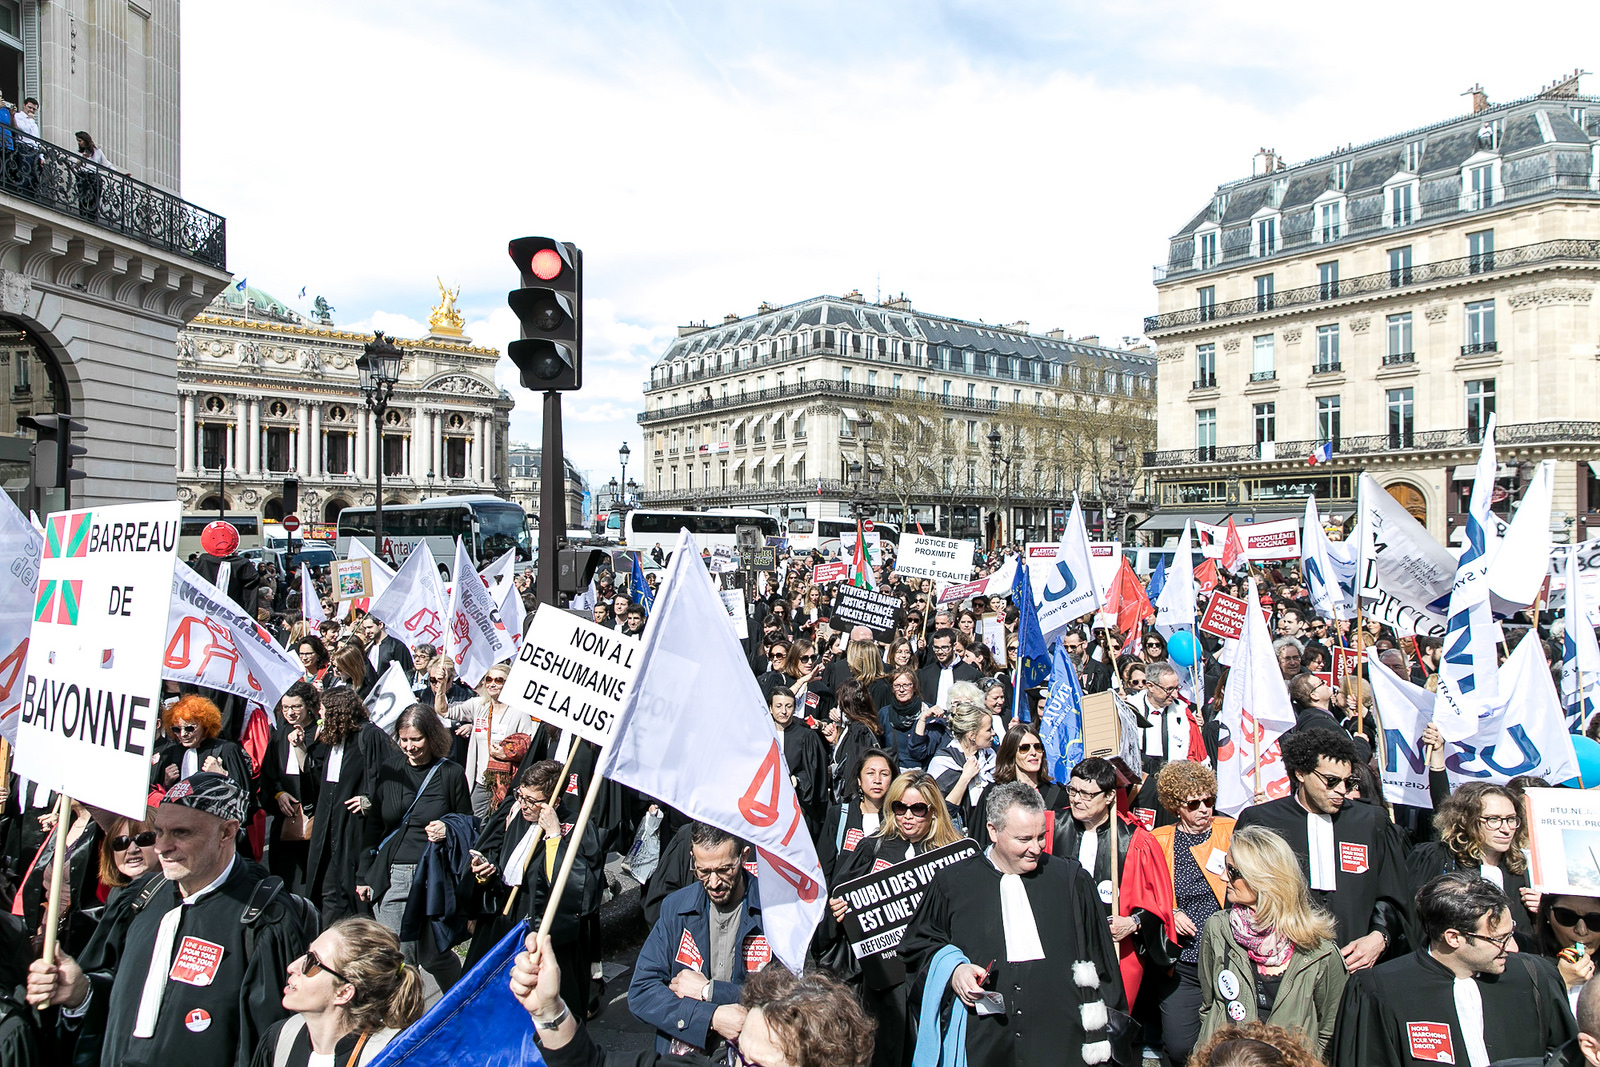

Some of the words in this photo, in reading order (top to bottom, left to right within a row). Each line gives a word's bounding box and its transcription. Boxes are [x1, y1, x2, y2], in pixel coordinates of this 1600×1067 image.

[212, 379, 251, 388] ACADEMIE
[257, 383, 292, 391] NATIONALE
[313, 388, 345, 396] MUSIQUE
[1178, 486, 1211, 496] MATY
[1276, 482, 1318, 492] MATY
[89, 521, 177, 553] BARREAU
[914, 537, 946, 548] JUSTICE
[1248, 531, 1295, 543] ANGOULÊME
[1256, 538, 1288, 548] COGNAC
[382, 537, 417, 563] AntaV
[896, 565, 927, 576] JUSTICE
[929, 569, 970, 582] D'EGALITE
[108, 585, 134, 616] DE
[839, 584, 869, 600] CITOYENS
[869, 591, 879, 602] EN
[877, 593, 902, 609] DANGER
[1217, 597, 1240, 611] NOUS
[841, 596, 866, 610] JUSTICE
[866, 602, 895, 618] MENACÉE
[180, 579, 288, 664] Magistrature
[461, 589, 503, 652] Magistrature
[835, 606, 863, 620] AVOCATS
[863, 612, 873, 623] EN
[871, 615, 895, 629] COLÈRE
[1211, 612, 1230, 624] POUR
[1208, 619, 1235, 635] DROITS
[570, 626, 610, 658] NON
[523, 679, 549, 706] DE
[548, 690, 571, 717] LA
[22, 674, 150, 756] BAYONNE
[888, 870, 918, 895] DES
[857, 907, 884, 933] EST
[882, 898, 914, 924] UNE
[185, 941, 198, 949] UNE
[198, 944, 218, 955] JUSTICE
[860, 929, 902, 955] REFUSONS
[180, 954, 197, 963] AVEC
[183, 947, 201, 956] POUR
[177, 960, 206, 973] PARTOUT
[1411, 1031, 1447, 1040] MARCHONS
